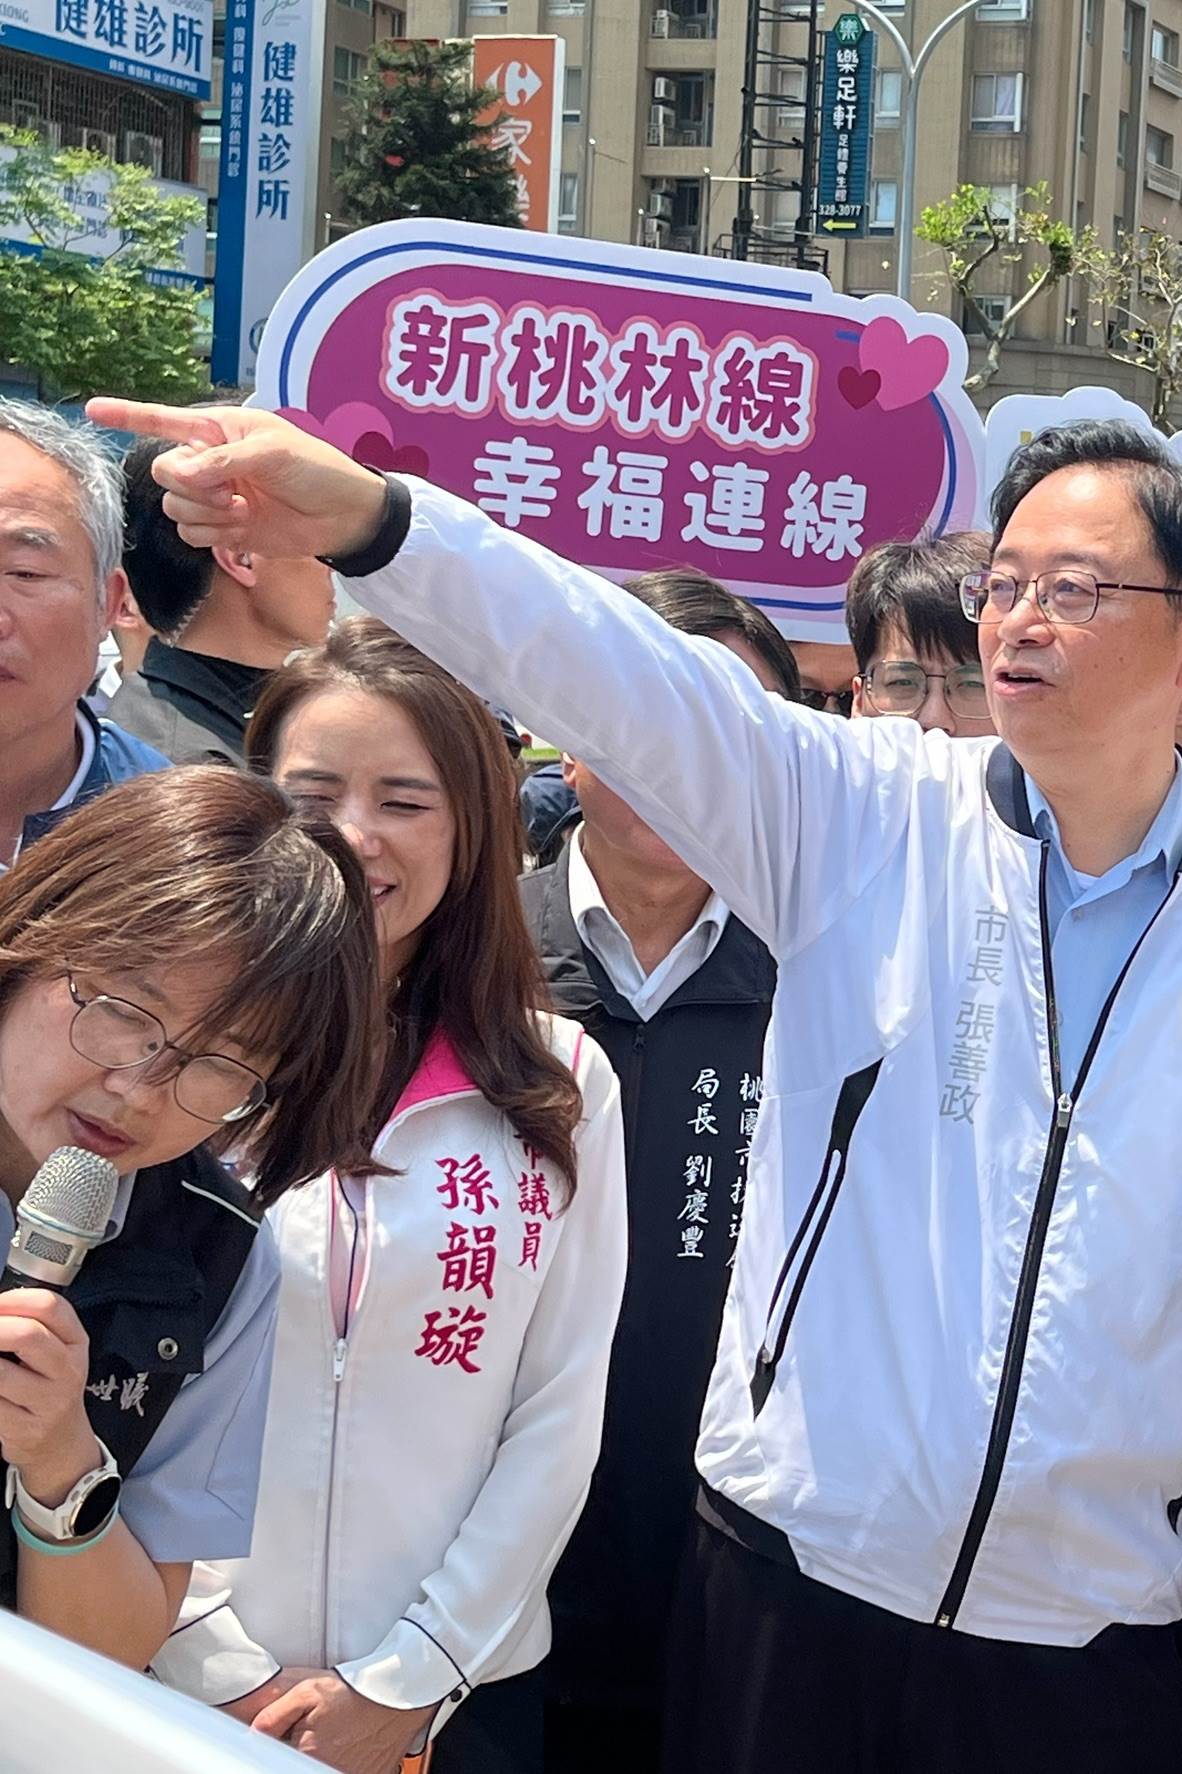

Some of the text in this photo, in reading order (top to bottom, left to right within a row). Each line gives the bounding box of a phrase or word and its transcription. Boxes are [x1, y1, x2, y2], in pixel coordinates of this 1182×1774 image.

[54, 0, 204, 73] 健雄診所
[832, 49, 859, 130] 樂足軒
[255, 41, 297, 220] 健雄診所
[818, 204, 862, 216] 328-3077
[397, 303, 806, 441] 新桃林線
[472, 436, 869, 562] 幸福連線
[938, 904, 1009, 1125] 市長 張善政
[676, 1067, 720, 1260] 局長 劉慶豐
[413, 1153, 501, 1375] 孫韻璇
